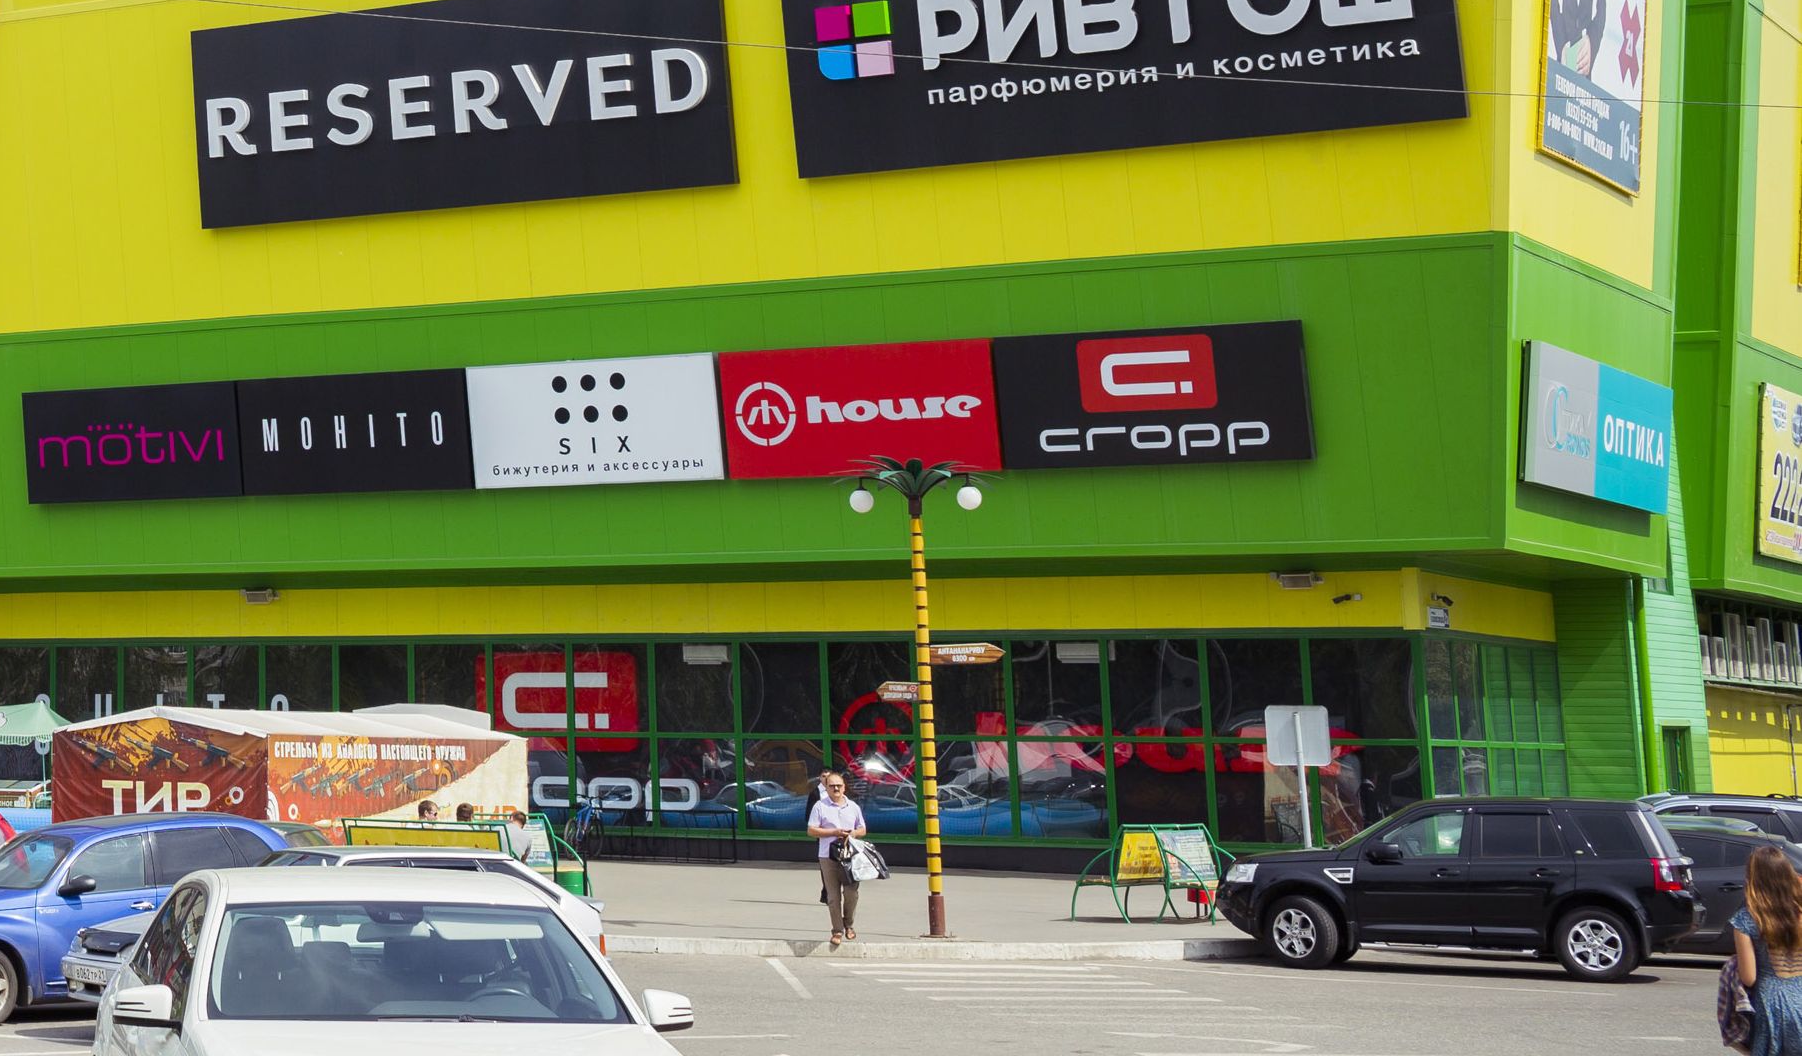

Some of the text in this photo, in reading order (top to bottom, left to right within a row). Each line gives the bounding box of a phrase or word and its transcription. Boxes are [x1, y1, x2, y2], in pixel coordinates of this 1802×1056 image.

[927, 37, 1421, 107] парфюмерия и косметика
[205, 47, 710, 159] RESERVED
[1619, 120, 1638, 165] 16+
[806, 393, 982, 424] house
[262, 411, 445, 453] MOHITO
[1039, 421, 1271, 456] cropp
[1603, 414, 1665, 468] ОПТИКА
[492, 455, 705, 479] бижутерия и аксессуары
[274, 741, 466, 763] СТРЕЛЬБА ИЗ АНАЛОГОВ НАСТОЯЩЕГО ОРУЖИЯ
